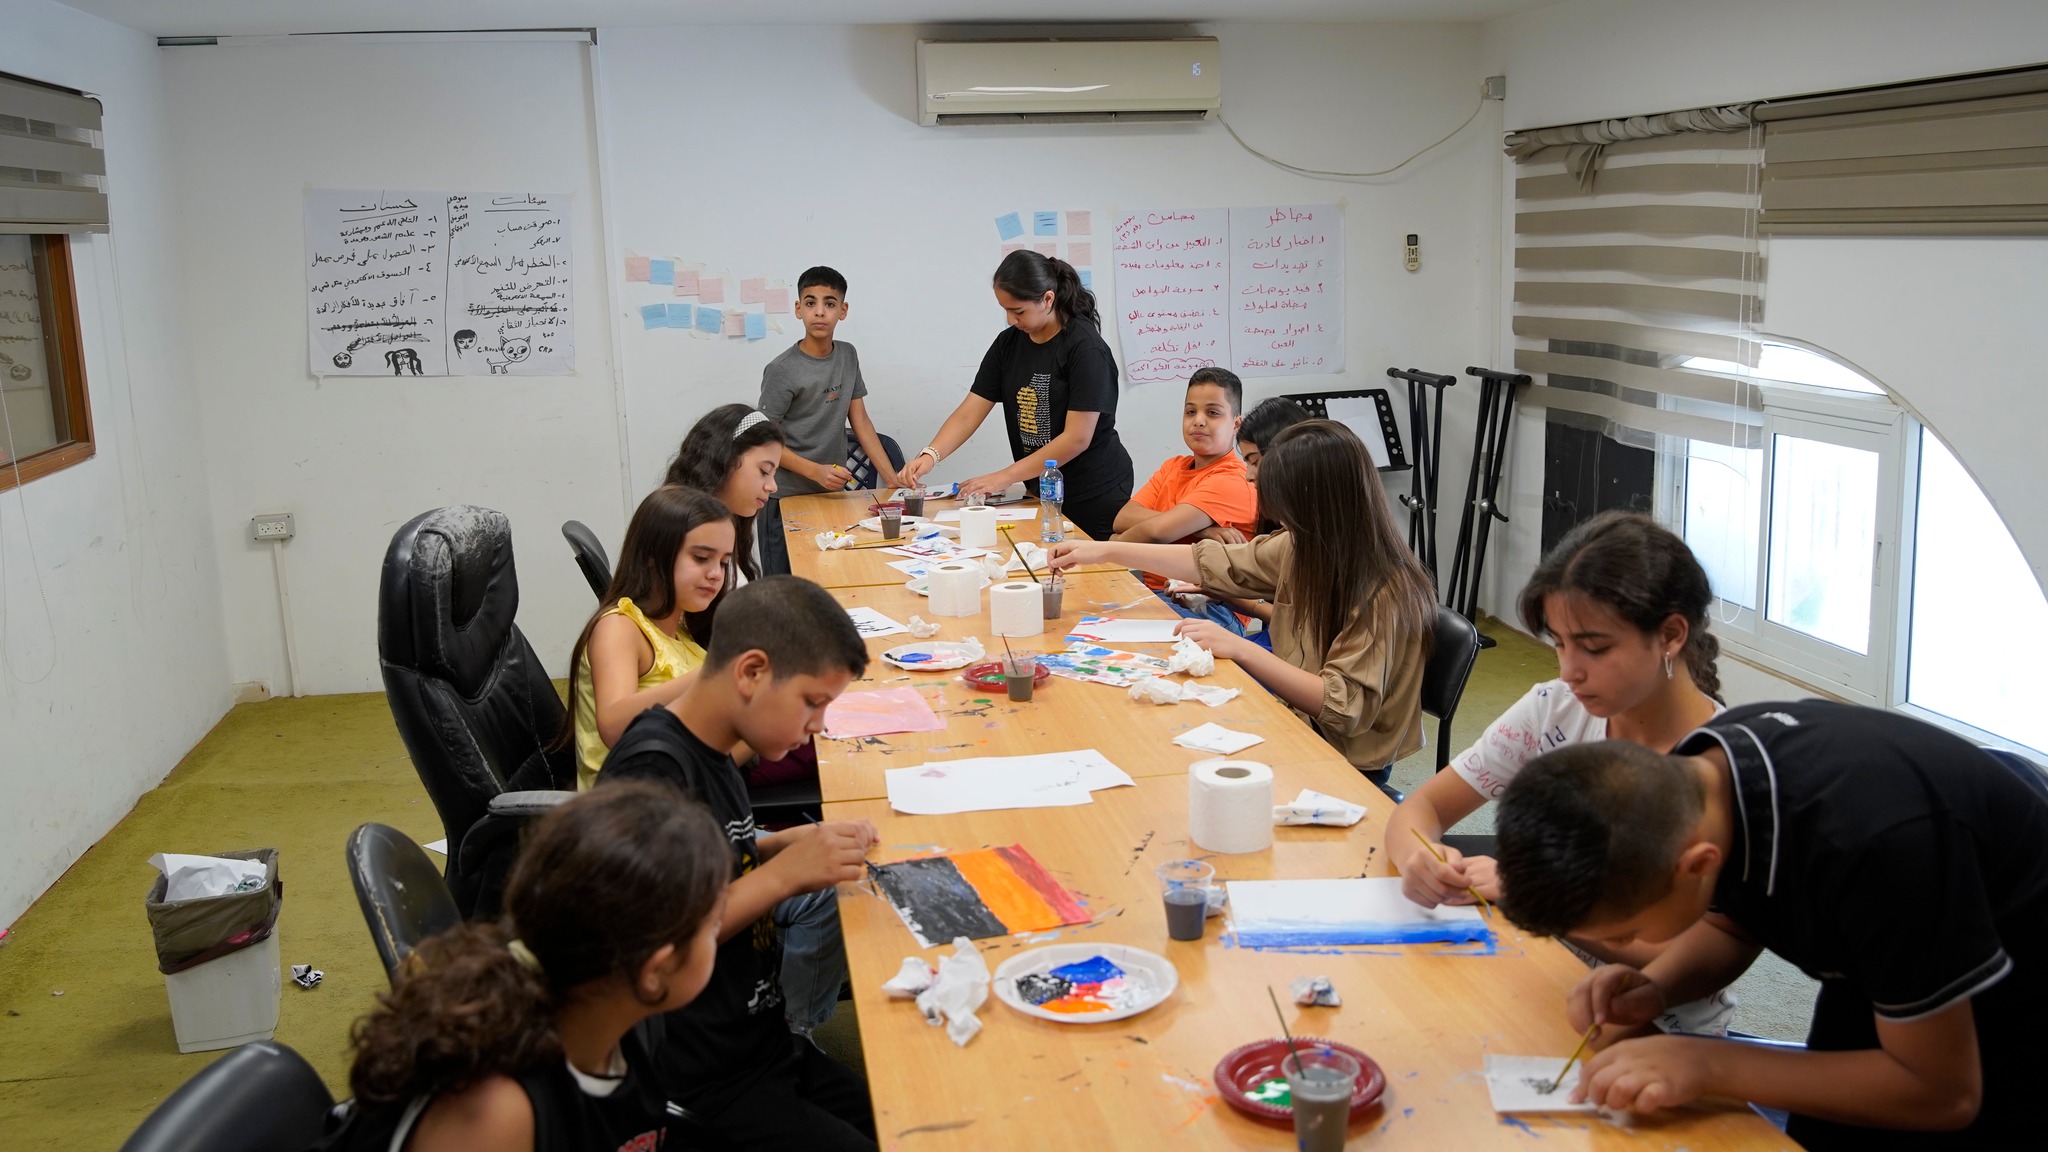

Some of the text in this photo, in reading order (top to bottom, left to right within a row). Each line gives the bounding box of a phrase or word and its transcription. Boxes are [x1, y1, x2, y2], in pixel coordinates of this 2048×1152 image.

[492, 193, 547, 206] سيئات
[1147, 211, 1195, 225] محاسن
[1265, 207, 1313, 228] مخاطر
[383, 244, 416, 261] الحصول
[1144, 260, 1185, 270] معلومات
[1252, 258, 1308, 273] تهديدات
[377, 266, 410, 279] التسوق
[519, 276, 556, 292] التعرض
[1132, 285, 1170, 297] التواصل
[362, 299, 386, 310] جديدة
